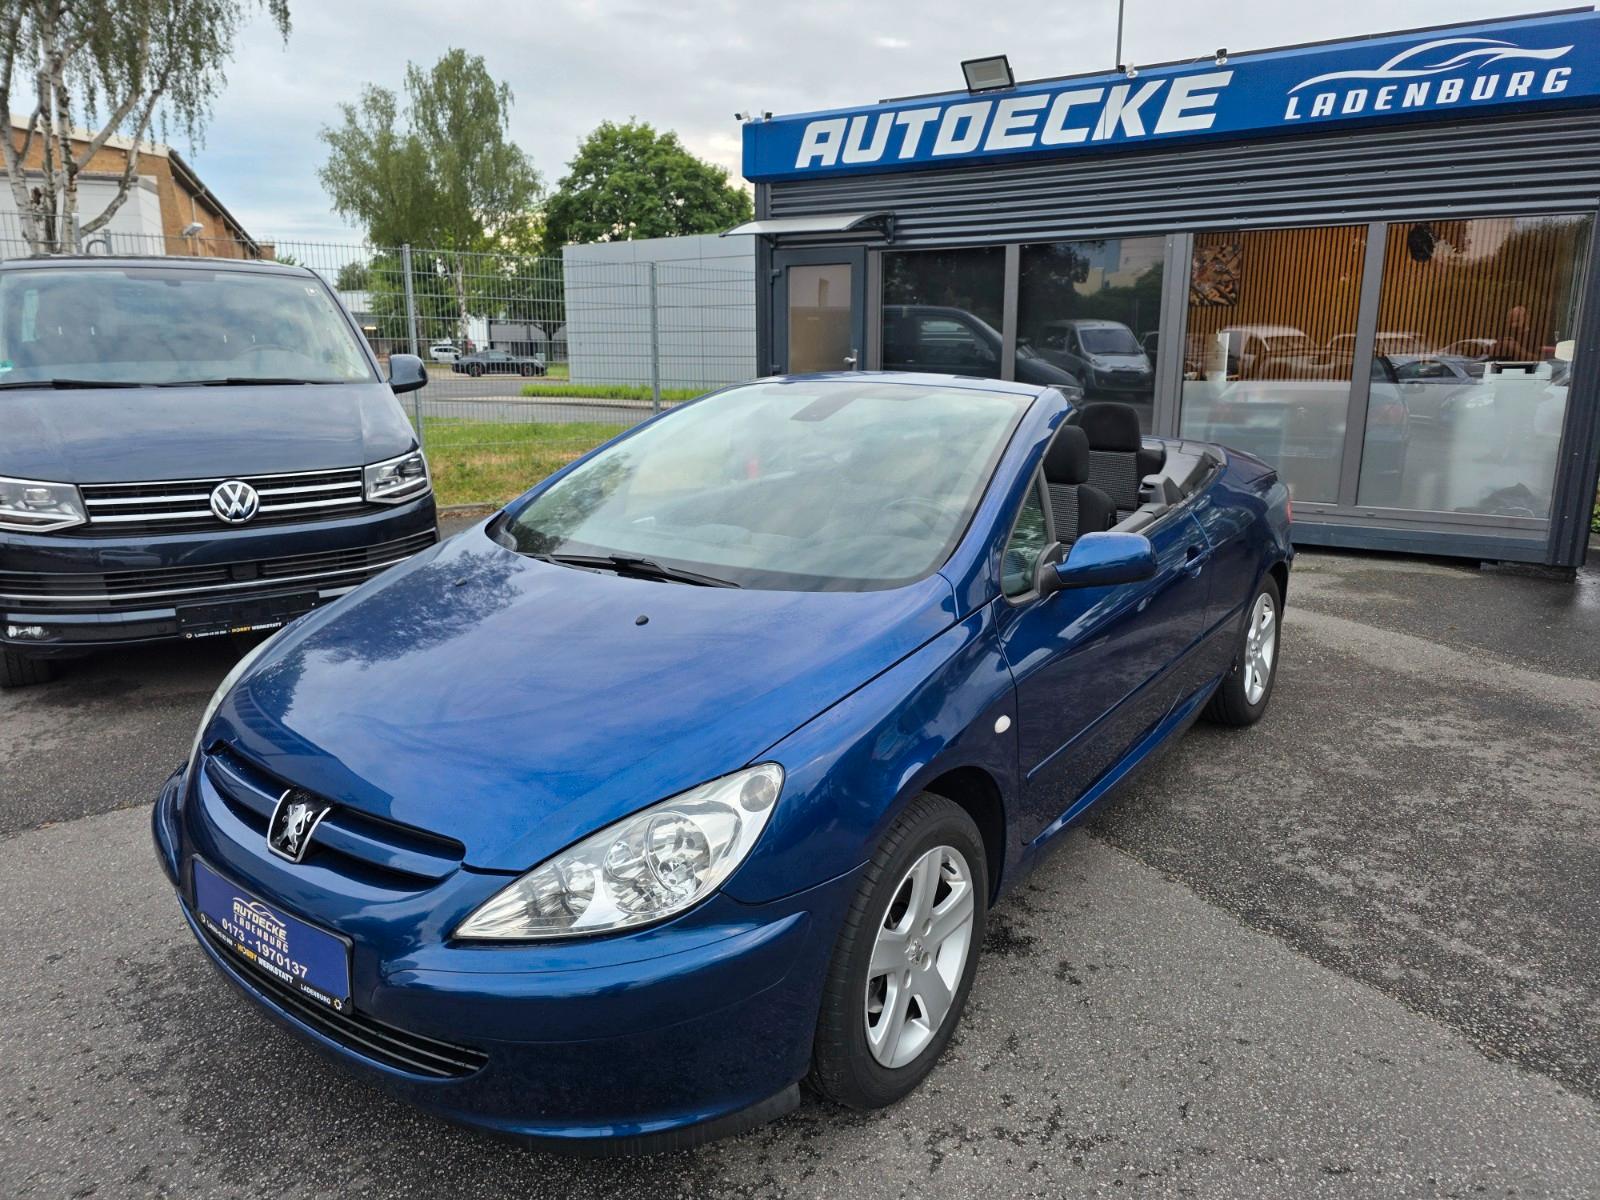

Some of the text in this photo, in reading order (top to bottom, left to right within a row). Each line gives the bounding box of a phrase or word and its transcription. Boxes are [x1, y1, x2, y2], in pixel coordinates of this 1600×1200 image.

[1284, 66, 1573, 120] LADENBURG
[794, 70, 1235, 169] AUTOECKE
[211, 481, 259, 523] VW
[232, 901, 287, 941] AUTOECKE
[233, 913, 289, 954] LADENBURG
[222, 917, 245, 942] 0173
[255, 940, 308, 978] 1970137
[257, 956, 294, 984] WERKSTATT
[300, 983, 331, 1005] LADENBURG
